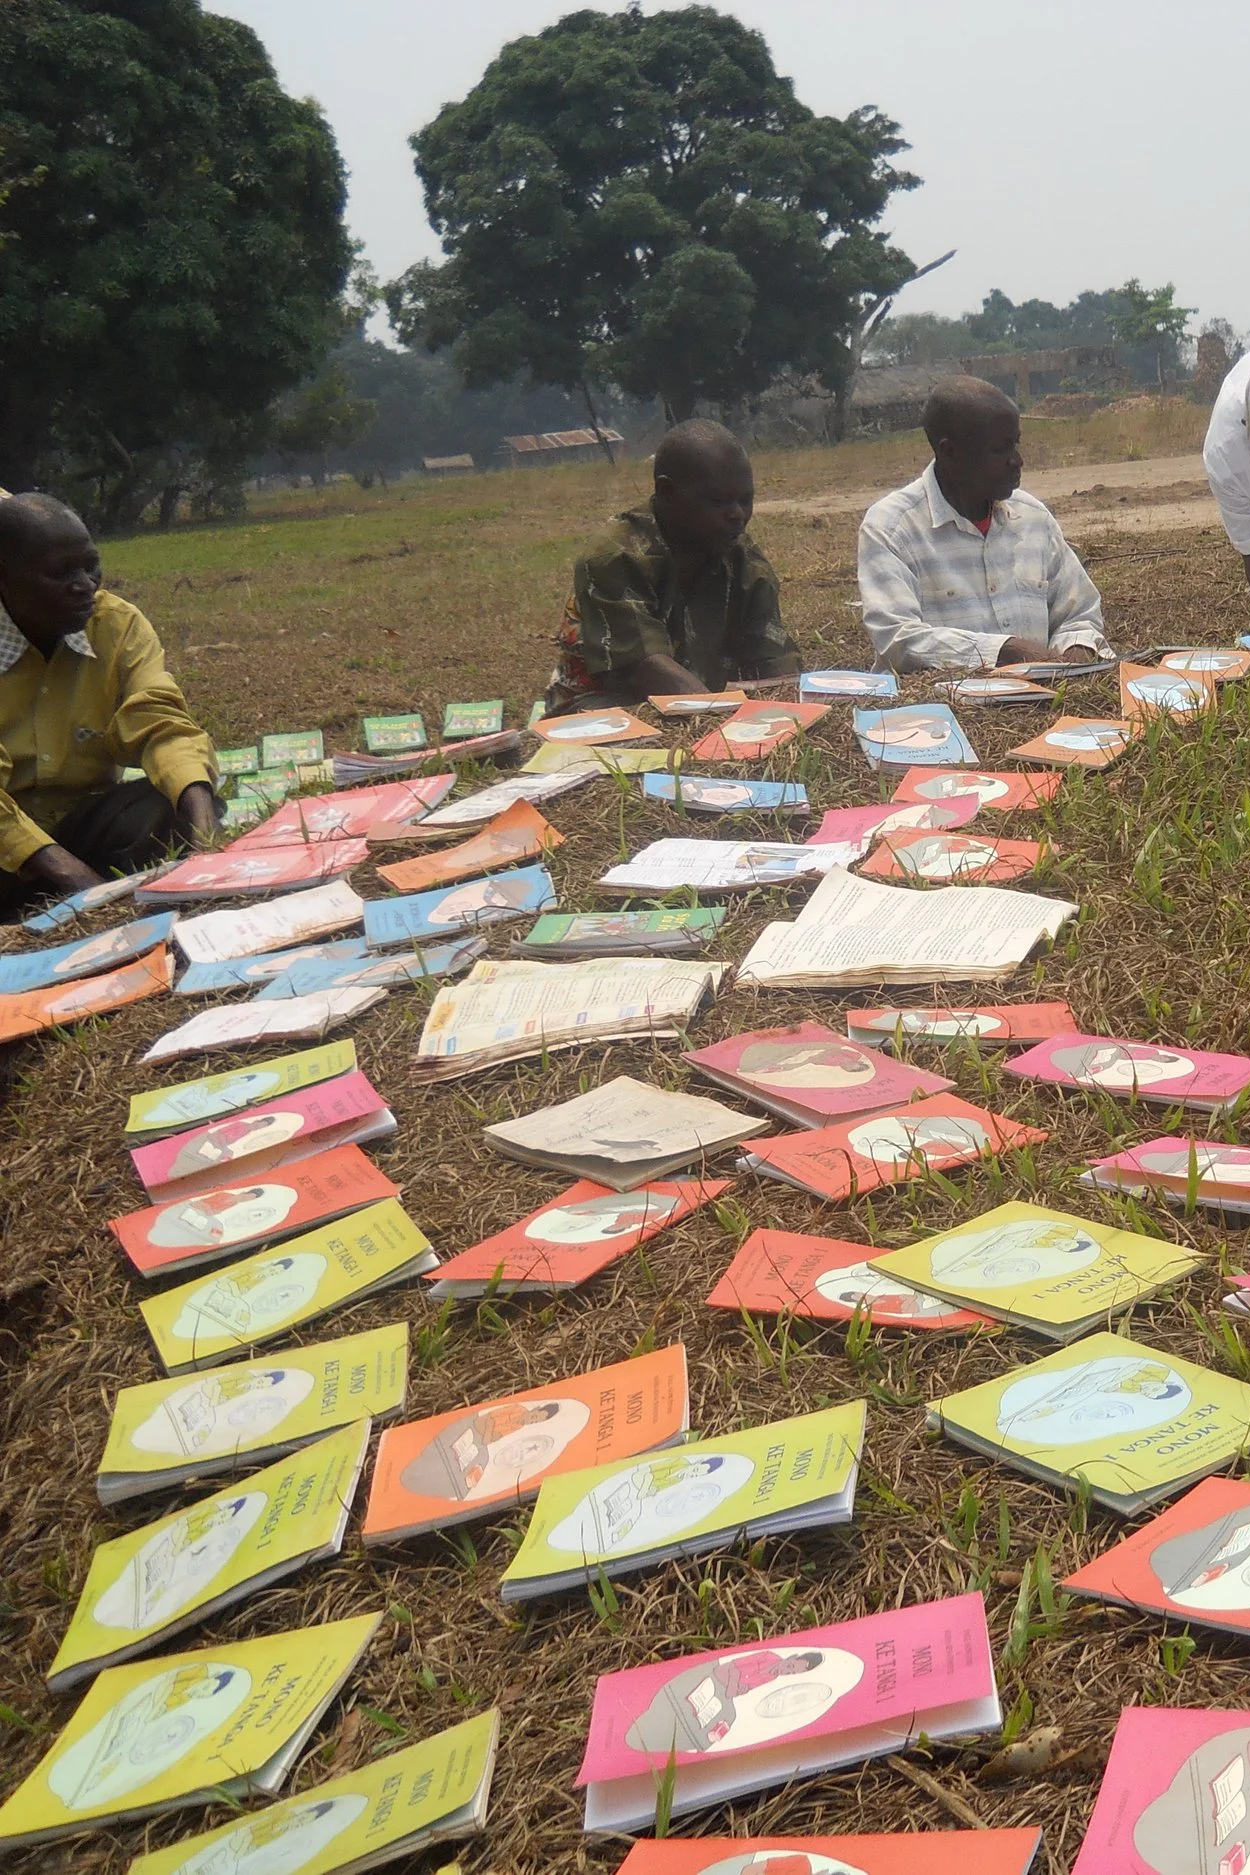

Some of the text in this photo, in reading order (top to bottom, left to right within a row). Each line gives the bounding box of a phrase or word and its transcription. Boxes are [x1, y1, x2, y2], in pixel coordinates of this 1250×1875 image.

[327, 1239, 344, 1253] KE
[336, 1246, 361, 1274] TANGA
[355, 1234, 379, 1256] MONO
[795, 1254, 824, 1277] TANGA
[1045, 1268, 1104, 1295] TANGA
[325, 1360, 339, 1375] KE
[350, 1364, 366, 1394] MONO
[322, 1375, 338, 1409] TANGA
[626, 1390, 643, 1425] MONO
[596, 1388, 616, 1451] KE TANGA 1
[1189, 1403, 1220, 1420] KE
[1119, 1421, 1190, 1453] TANGA
[1156, 1422, 1221, 1455] MONO
[752, 1443, 785, 1505] KE TANGA 1
[790, 1448, 814, 1481] MONO
[278, 1472, 296, 1493] KE
[290, 1473, 317, 1515] MONO
[260, 1491, 289, 1540] TANGA
[876, 1640, 895, 1660] KE
[262, 1662, 288, 1688] KE
[876, 1660, 896, 1696] TANGA
[255, 1675, 302, 1728] MONO
[217, 1689, 270, 1748] TANGA
[383, 1771, 403, 1793] KE
[408, 1768, 434, 1806] MONO
[369, 1789, 398, 1830] TANGA
